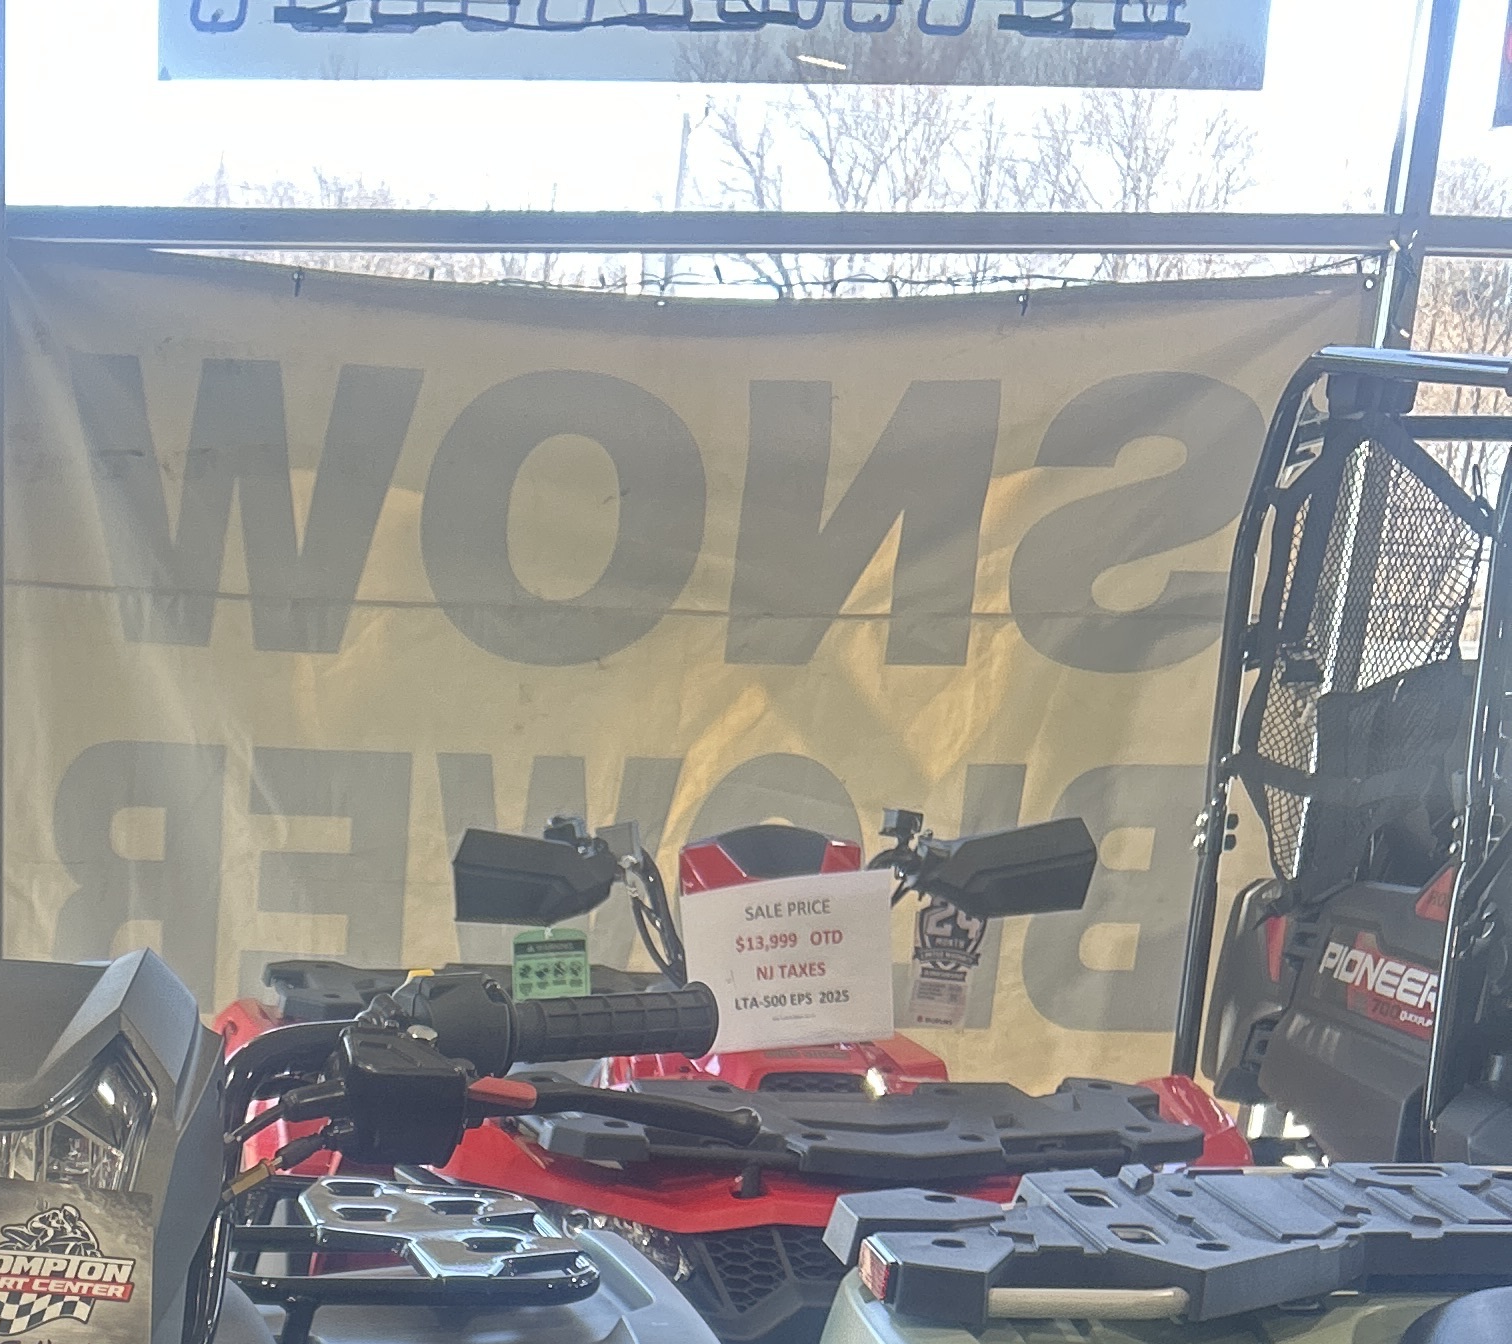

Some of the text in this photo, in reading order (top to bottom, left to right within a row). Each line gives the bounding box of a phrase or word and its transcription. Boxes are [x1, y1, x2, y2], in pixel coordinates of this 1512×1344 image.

[744, 899, 831, 921] SALE PRICE
[735, 929, 843, 953] $13,999 OTD
[756, 962, 826, 980] NJ TAXES
[735, 989, 850, 1010] LTA-500 EPS 2025
[31, 1277, 126, 1298] CENTER
